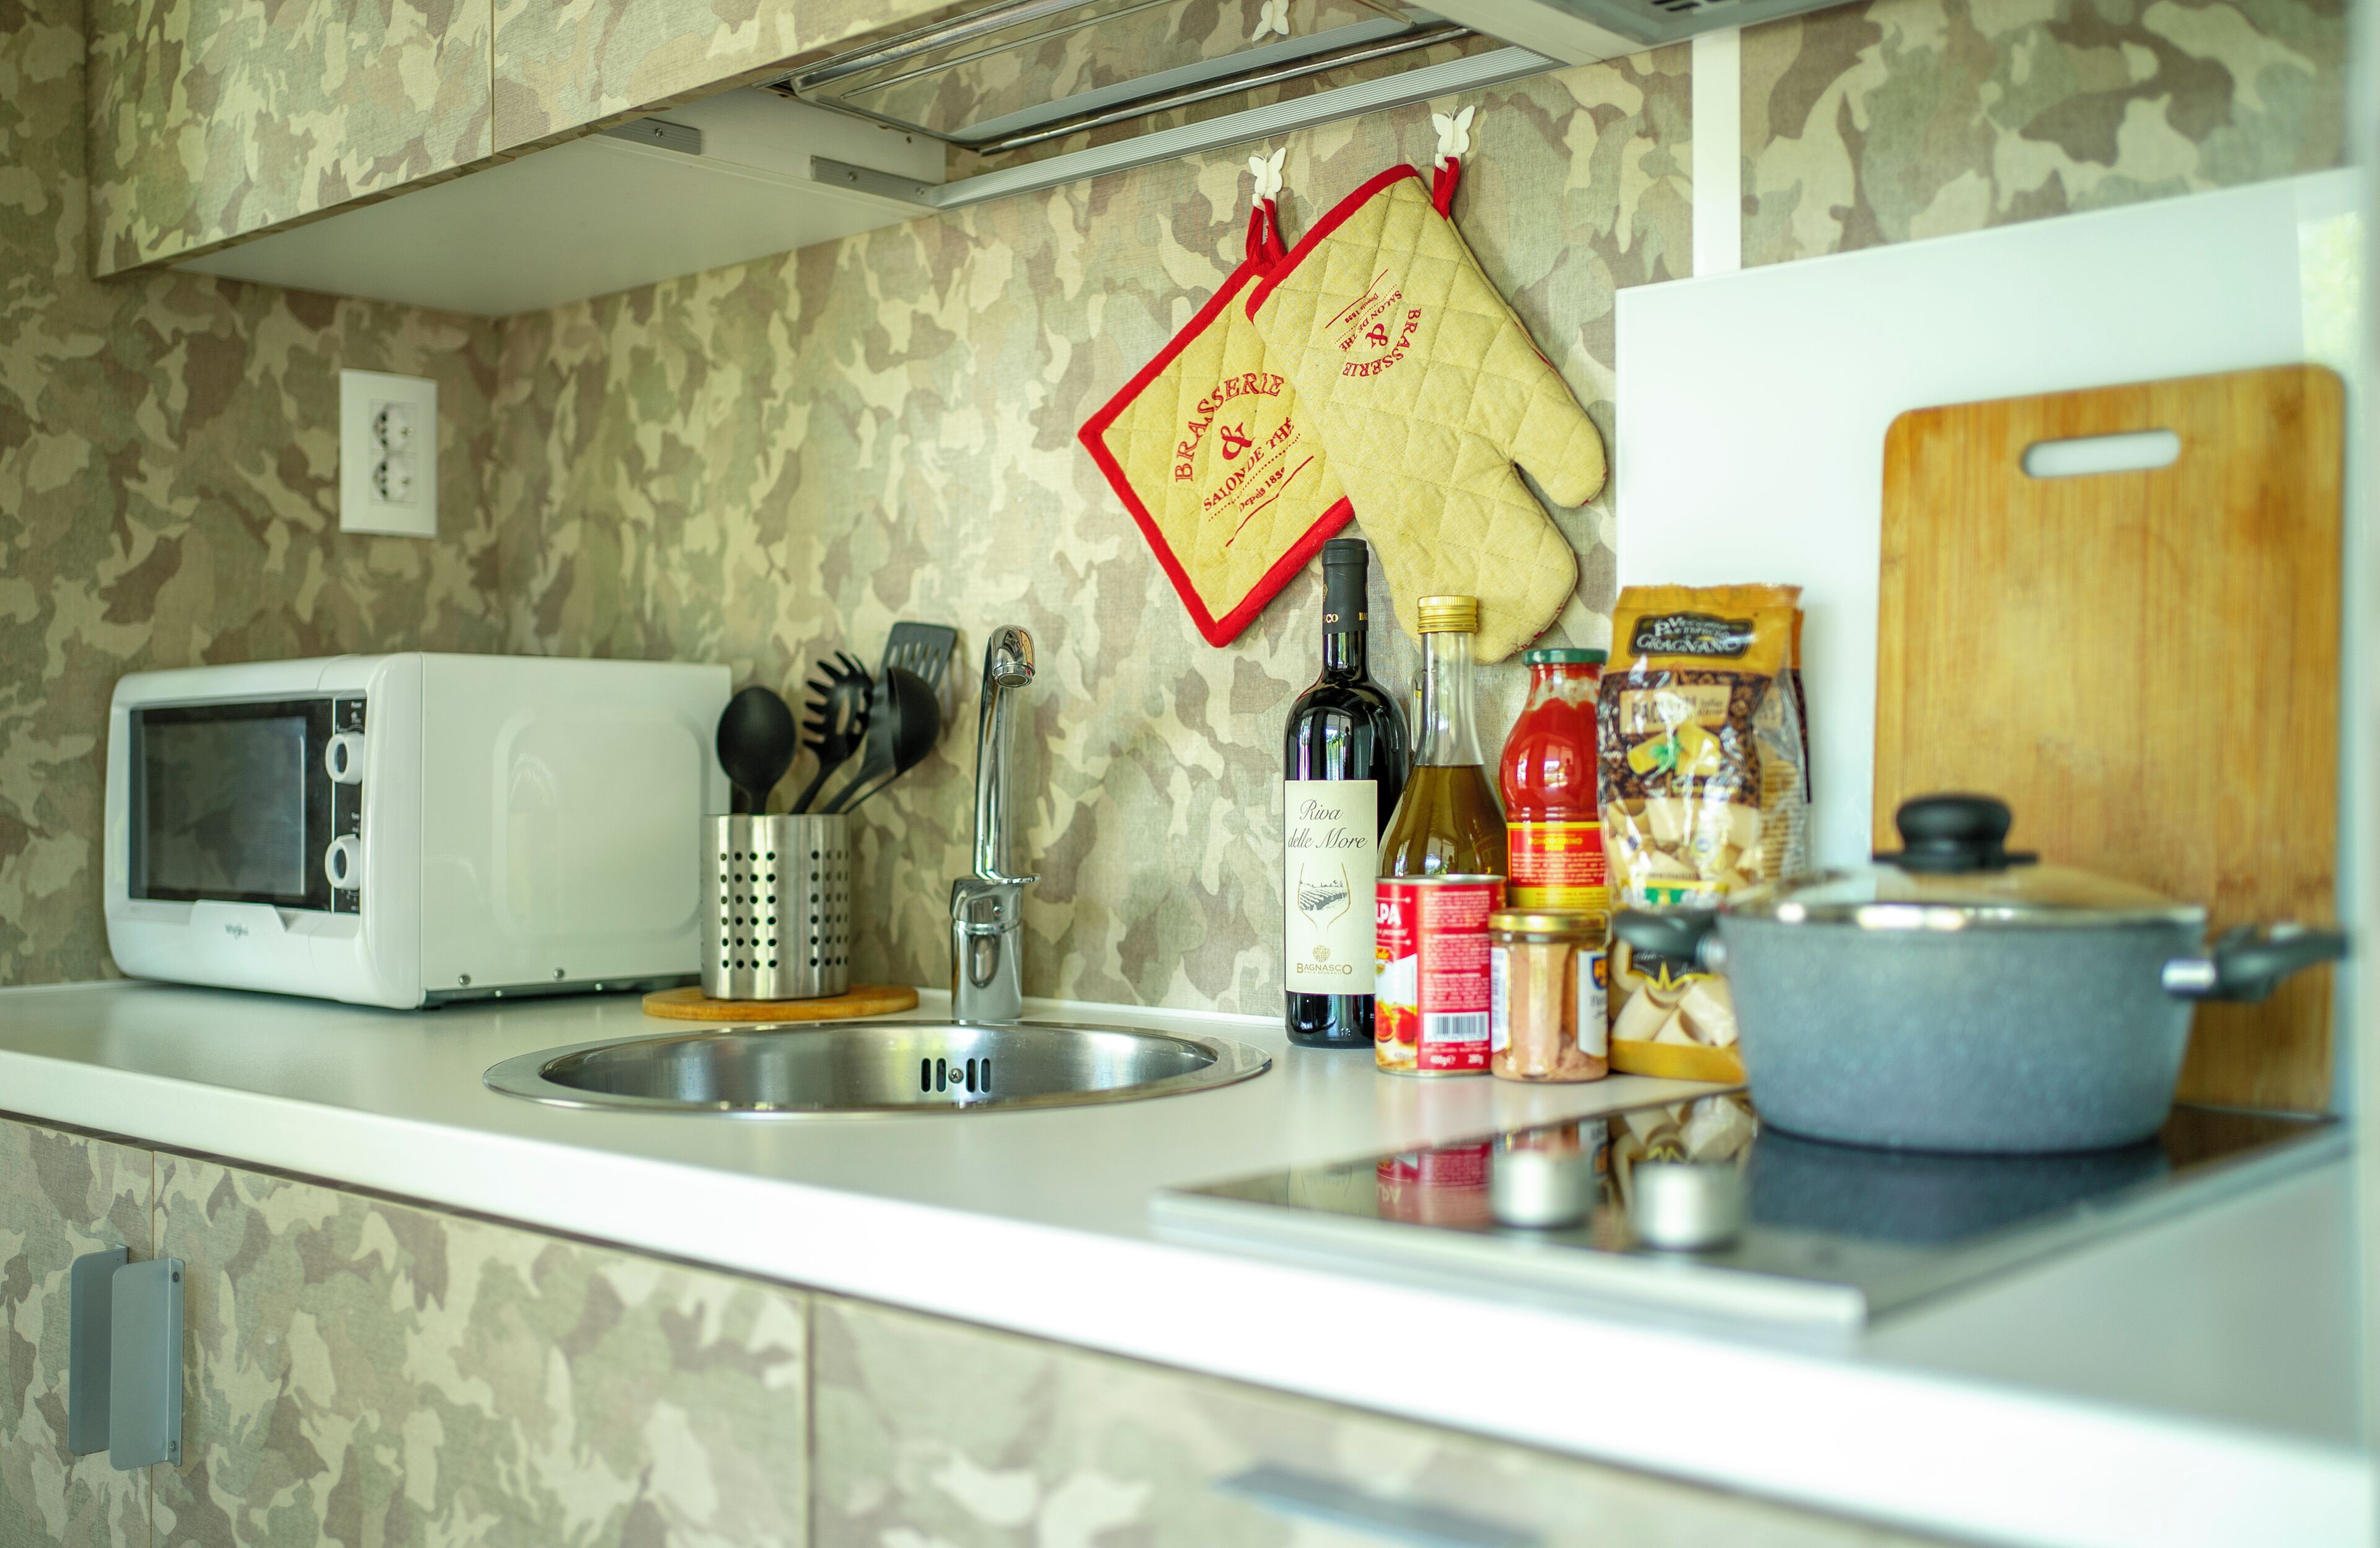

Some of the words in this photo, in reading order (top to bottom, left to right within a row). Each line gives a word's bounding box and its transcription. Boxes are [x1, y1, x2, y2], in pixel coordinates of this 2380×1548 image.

[1360, 292, 1379, 310] Depuis
[1370, 291, 1403, 320] SALON
[1358, 317, 1370, 333] DE
[1365, 323, 1388, 349] &
[1342, 308, 1422, 377] BRASSERIE
[1175, 372, 1285, 483] BRASSERIE
[1220, 421, 1256, 460] &
[1203, 467, 1247, 512] SALON
[1245, 446, 1265, 473] DE
[1239, 486, 1266, 513] Depuis
[1300, 799, 1344, 820] Riva
[1288, 828, 1314, 848] delle
[1315, 827, 1368, 848] More
[1297, 963, 1352, 975] BAGNASCO
